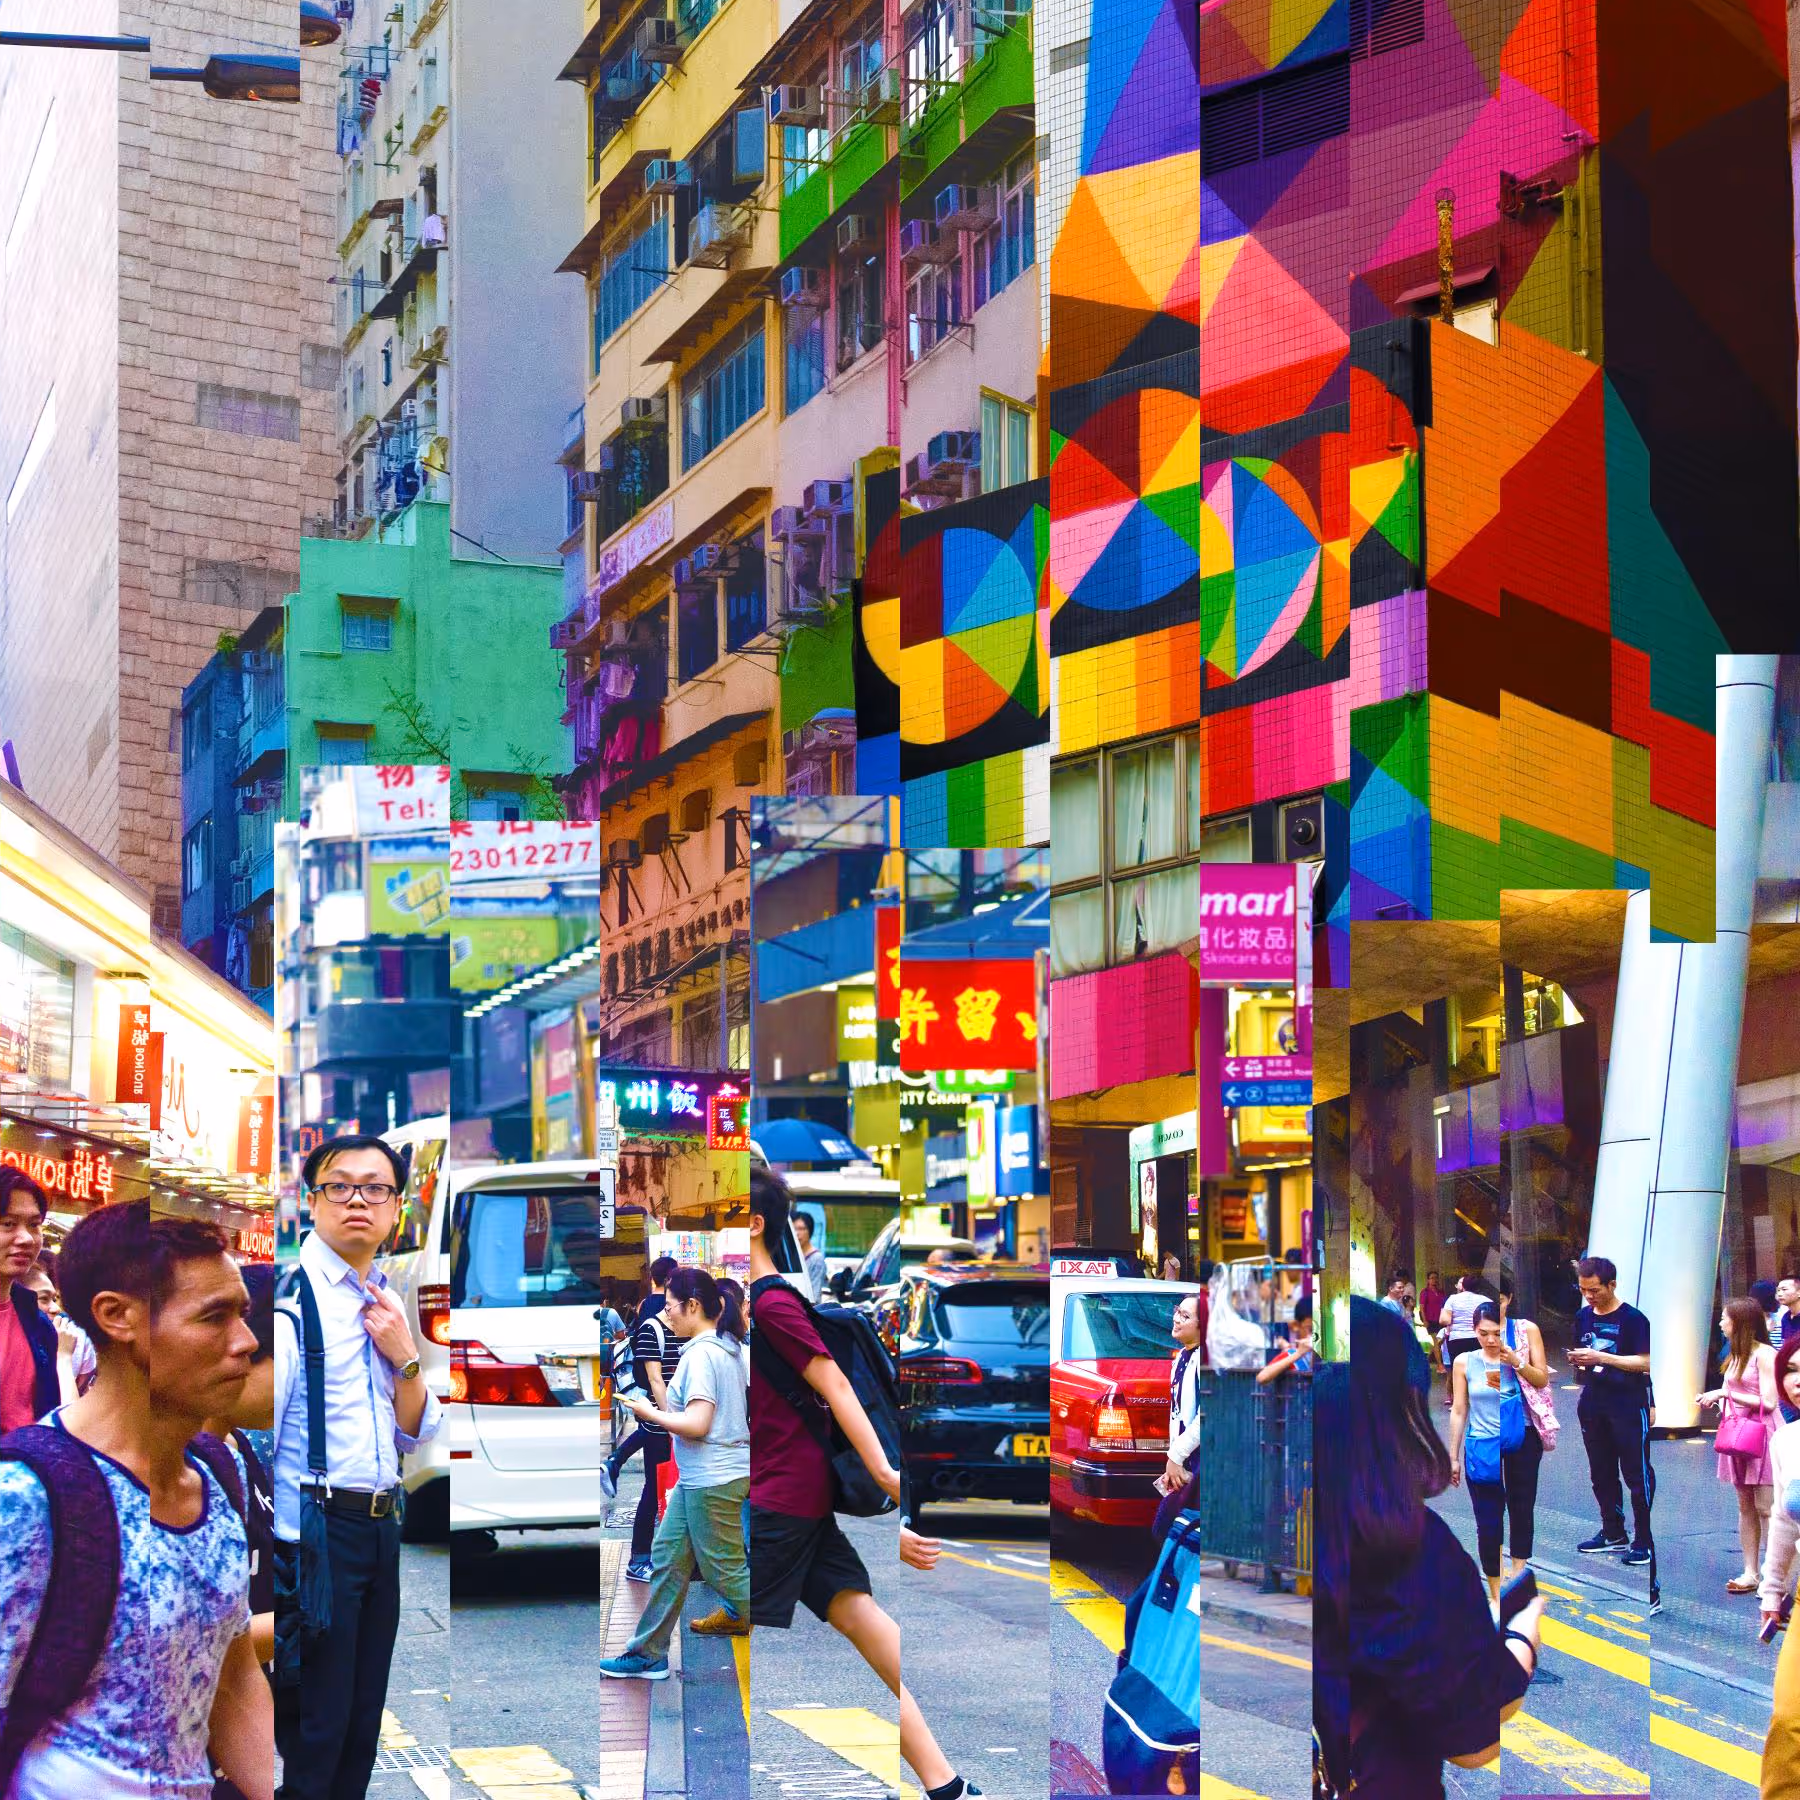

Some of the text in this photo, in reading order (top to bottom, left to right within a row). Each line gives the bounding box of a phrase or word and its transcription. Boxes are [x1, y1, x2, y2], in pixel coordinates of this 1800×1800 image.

[378, 800, 435, 822] Tel:
[451, 841, 593, 871] 23012277
[1203, 953, 1258, 965] Skincare
